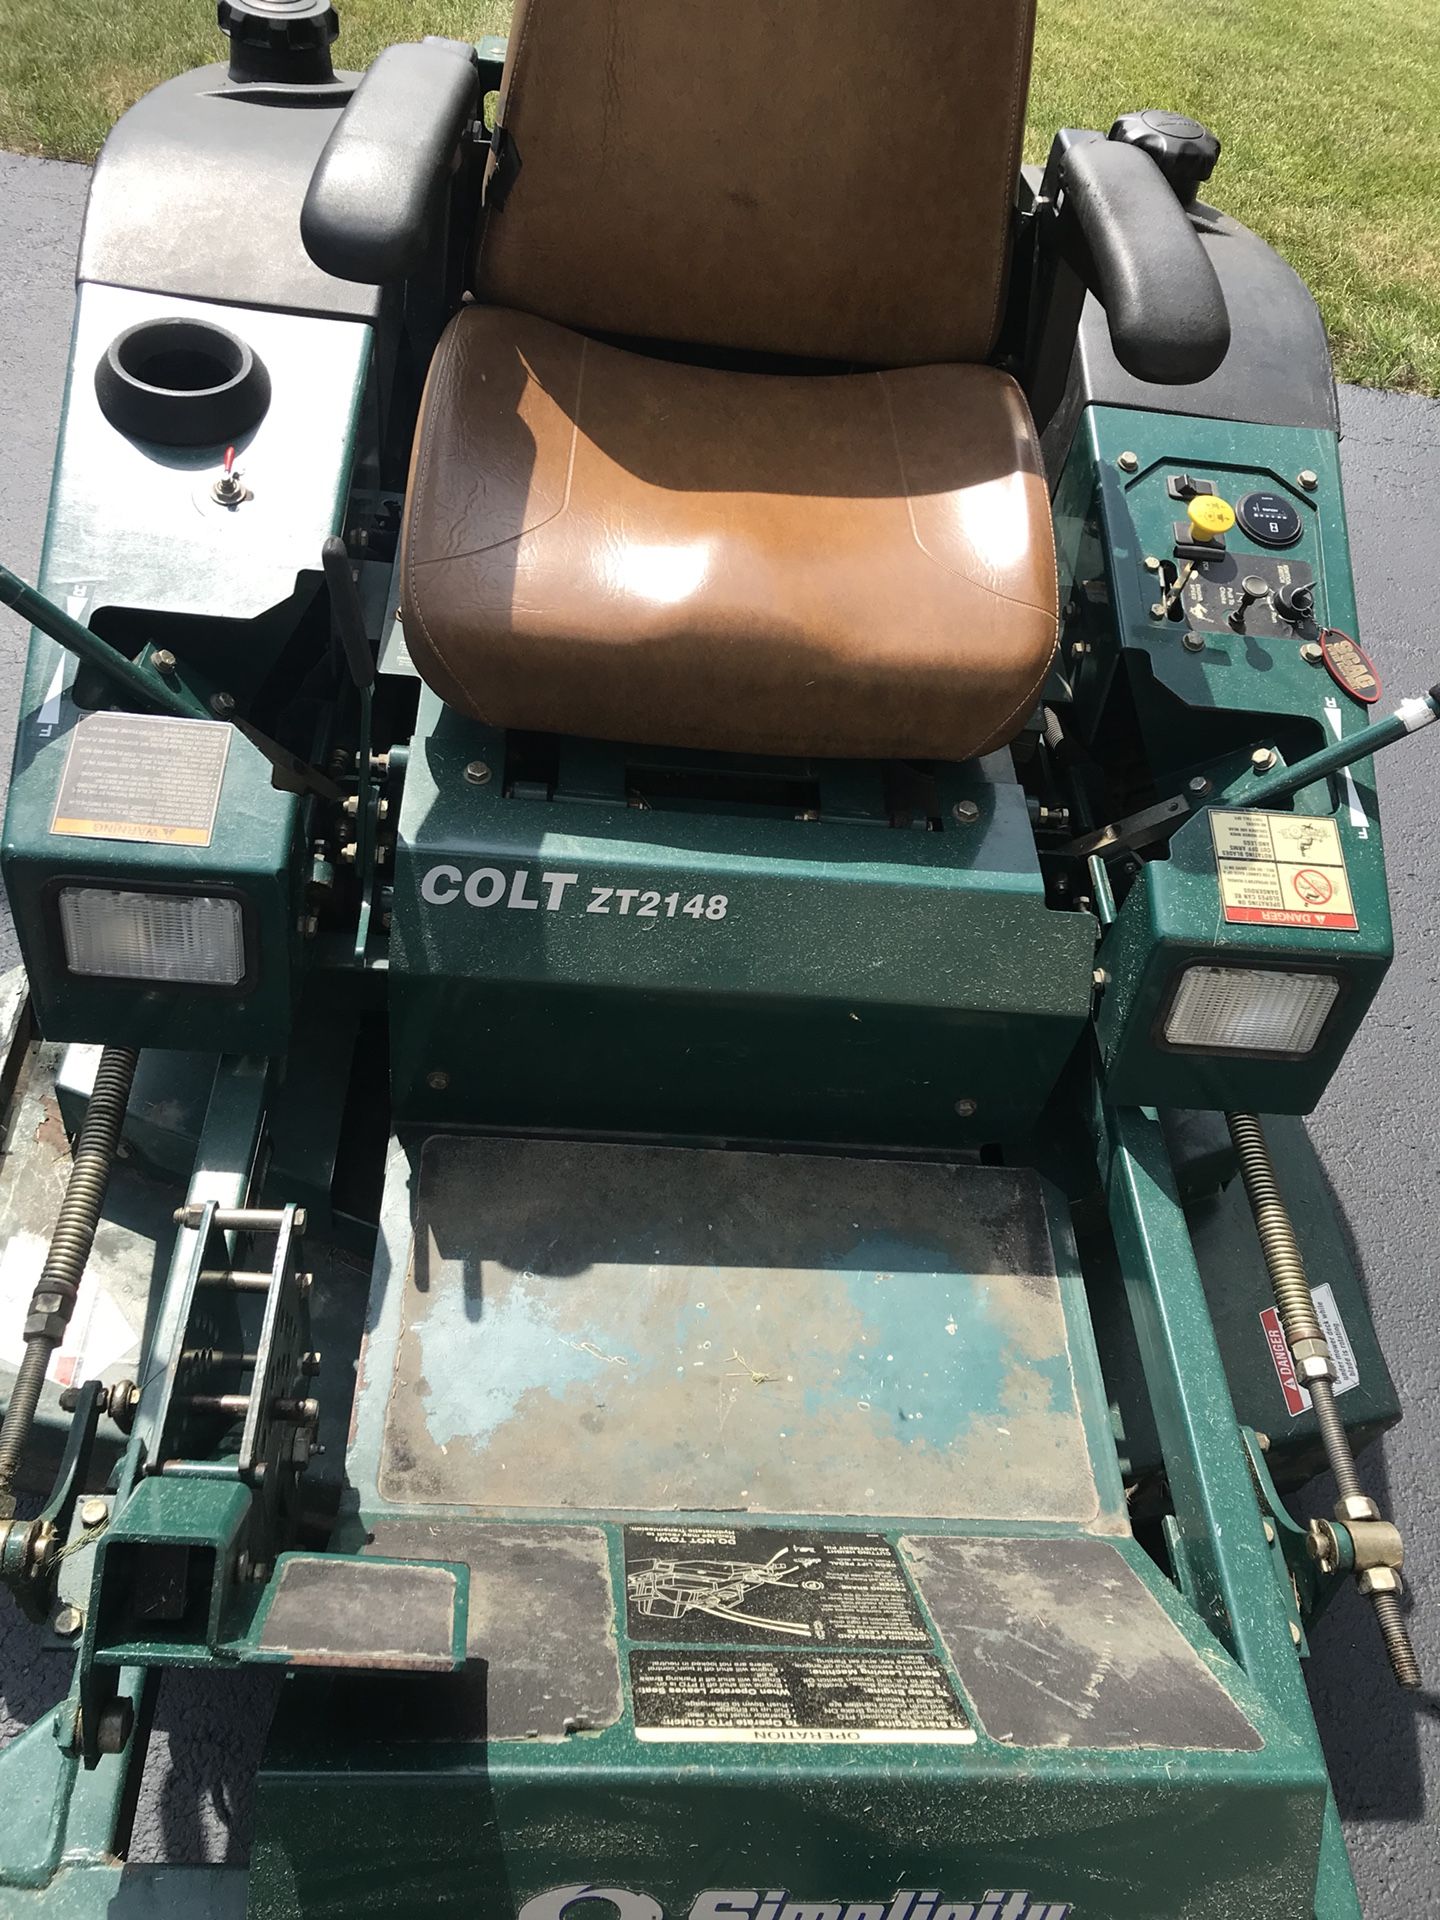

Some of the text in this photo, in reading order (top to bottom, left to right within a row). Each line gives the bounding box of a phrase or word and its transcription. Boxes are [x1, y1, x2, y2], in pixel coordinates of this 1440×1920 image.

[1335, 640, 1376, 689] SCAG
[1324, 697, 1337, 708] R
[39, 724, 53, 737] F
[92, 823, 158, 838] WARNING
[1357, 827, 1368, 840] F
[420, 864, 729, 920] COLT ZT2148
[1248, 900, 1281, 908] OPERATING
[1261, 911, 1312, 923] DANGER
[1268, 1329, 1292, 1375] DANGER
[1330, 1336, 1342, 1361] mower
[860, 1669, 902, 1677] Leaving
[638, 1687, 666, 1695] Seat:
[710, 1688, 757, 1696] Operator
[760, 1689, 790, 1697] When
[863, 1688, 906, 1696] Engine:
[908, 1689, 935, 1697] Stop
[708, 1719, 733, 1727] PTO
[736, 1719, 783, 1727] Operate
[920, 1720, 949, 1729] Start
[950, 1721, 965, 1729] To
[754, 1731, 860, 1741] OPERATION
